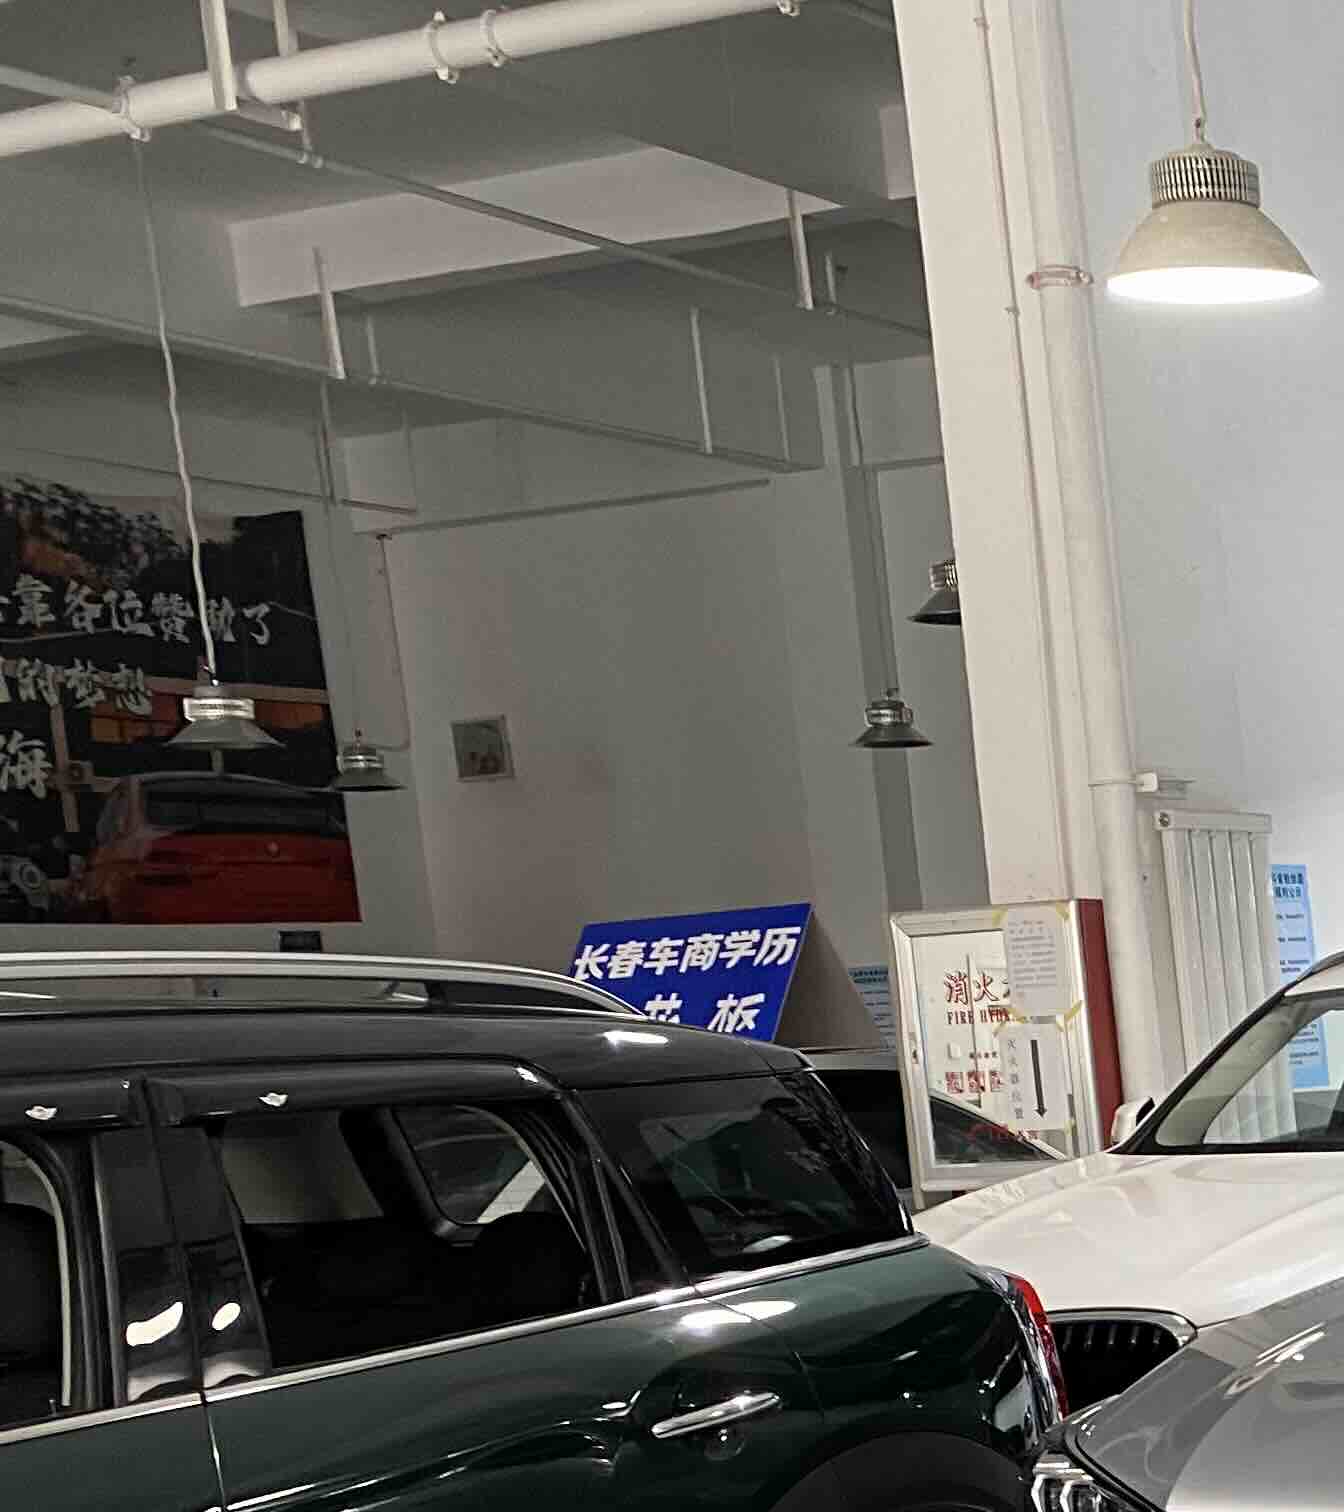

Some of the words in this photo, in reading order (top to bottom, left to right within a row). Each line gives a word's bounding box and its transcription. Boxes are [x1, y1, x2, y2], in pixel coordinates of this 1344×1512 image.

[574, 926, 801, 981] 长春车商学历
